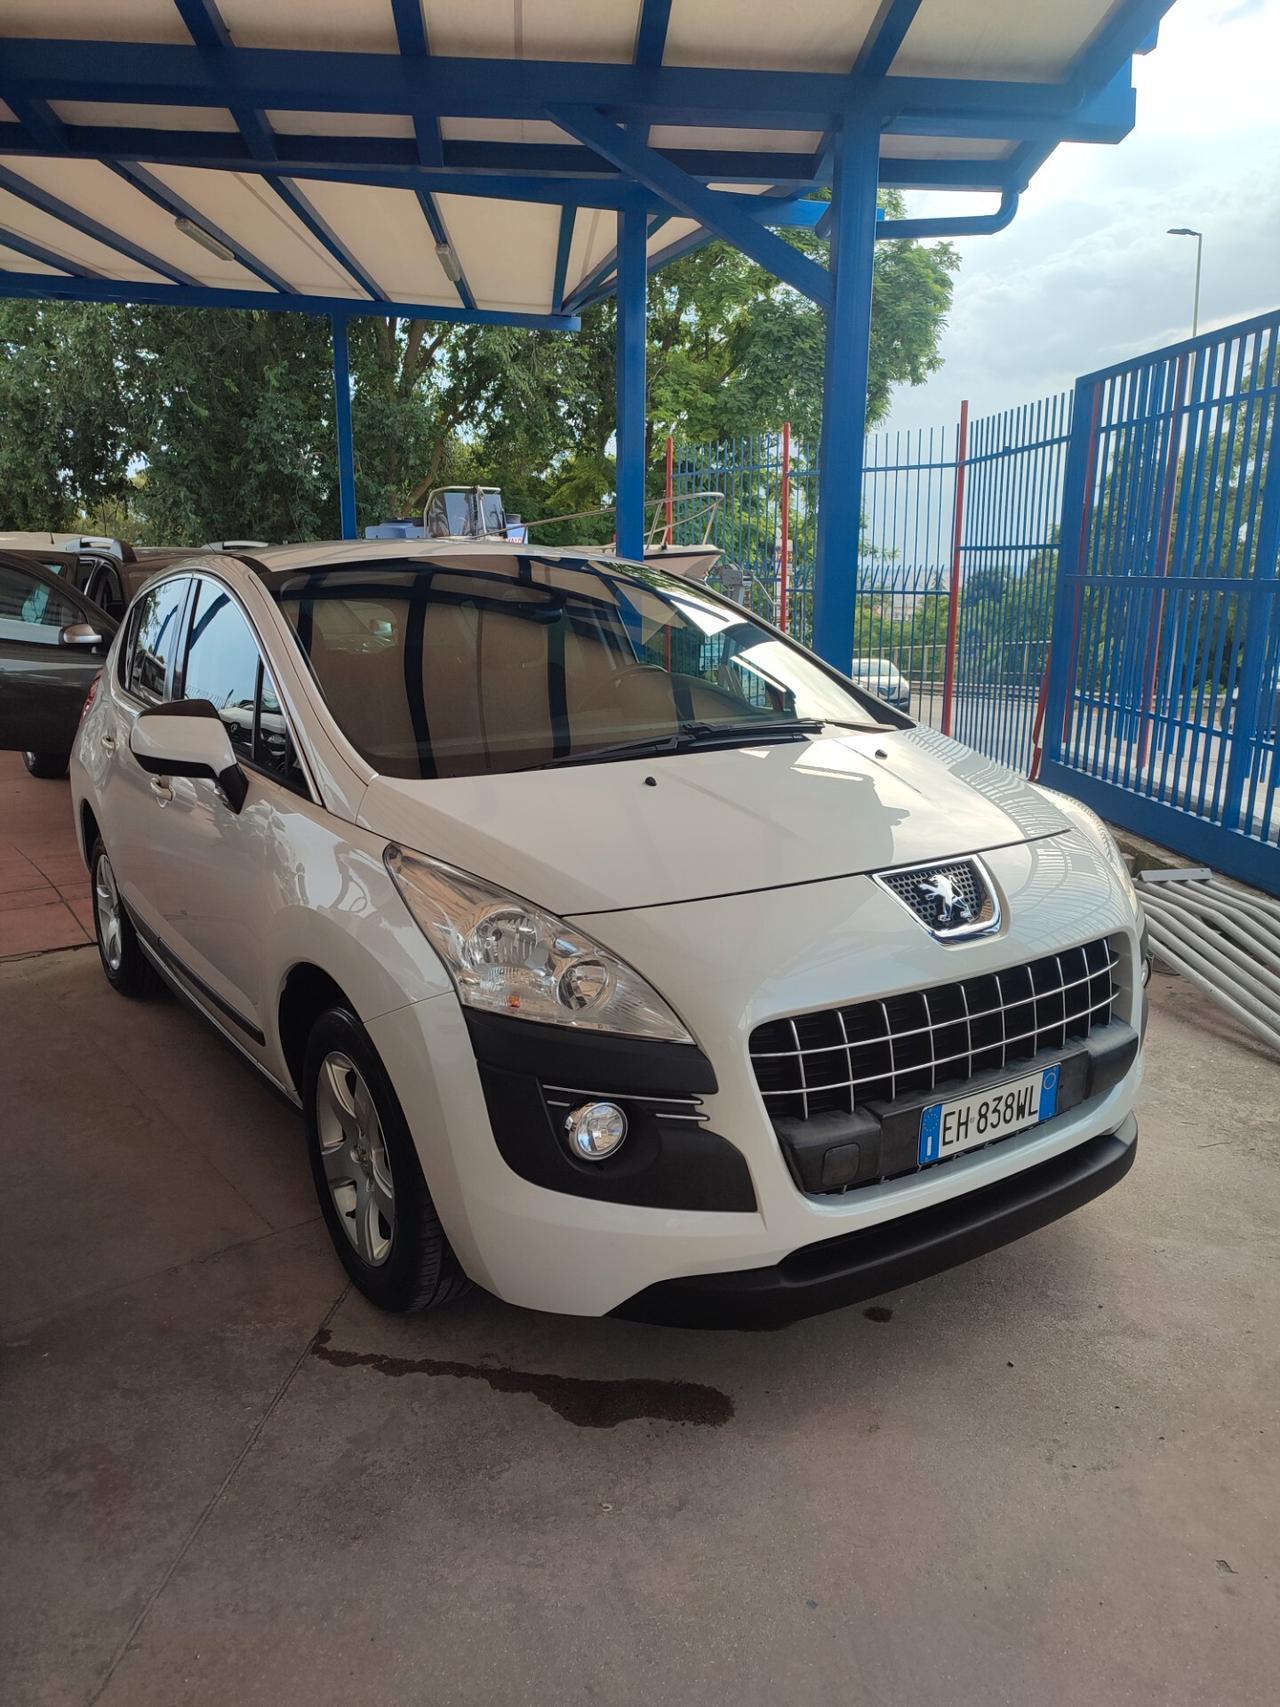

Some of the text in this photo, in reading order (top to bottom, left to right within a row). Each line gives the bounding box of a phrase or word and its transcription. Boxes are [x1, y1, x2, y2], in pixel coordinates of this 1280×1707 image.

[942, 1085, 1039, 1147] EH 838WL
[926, 1135, 933, 1157] I
